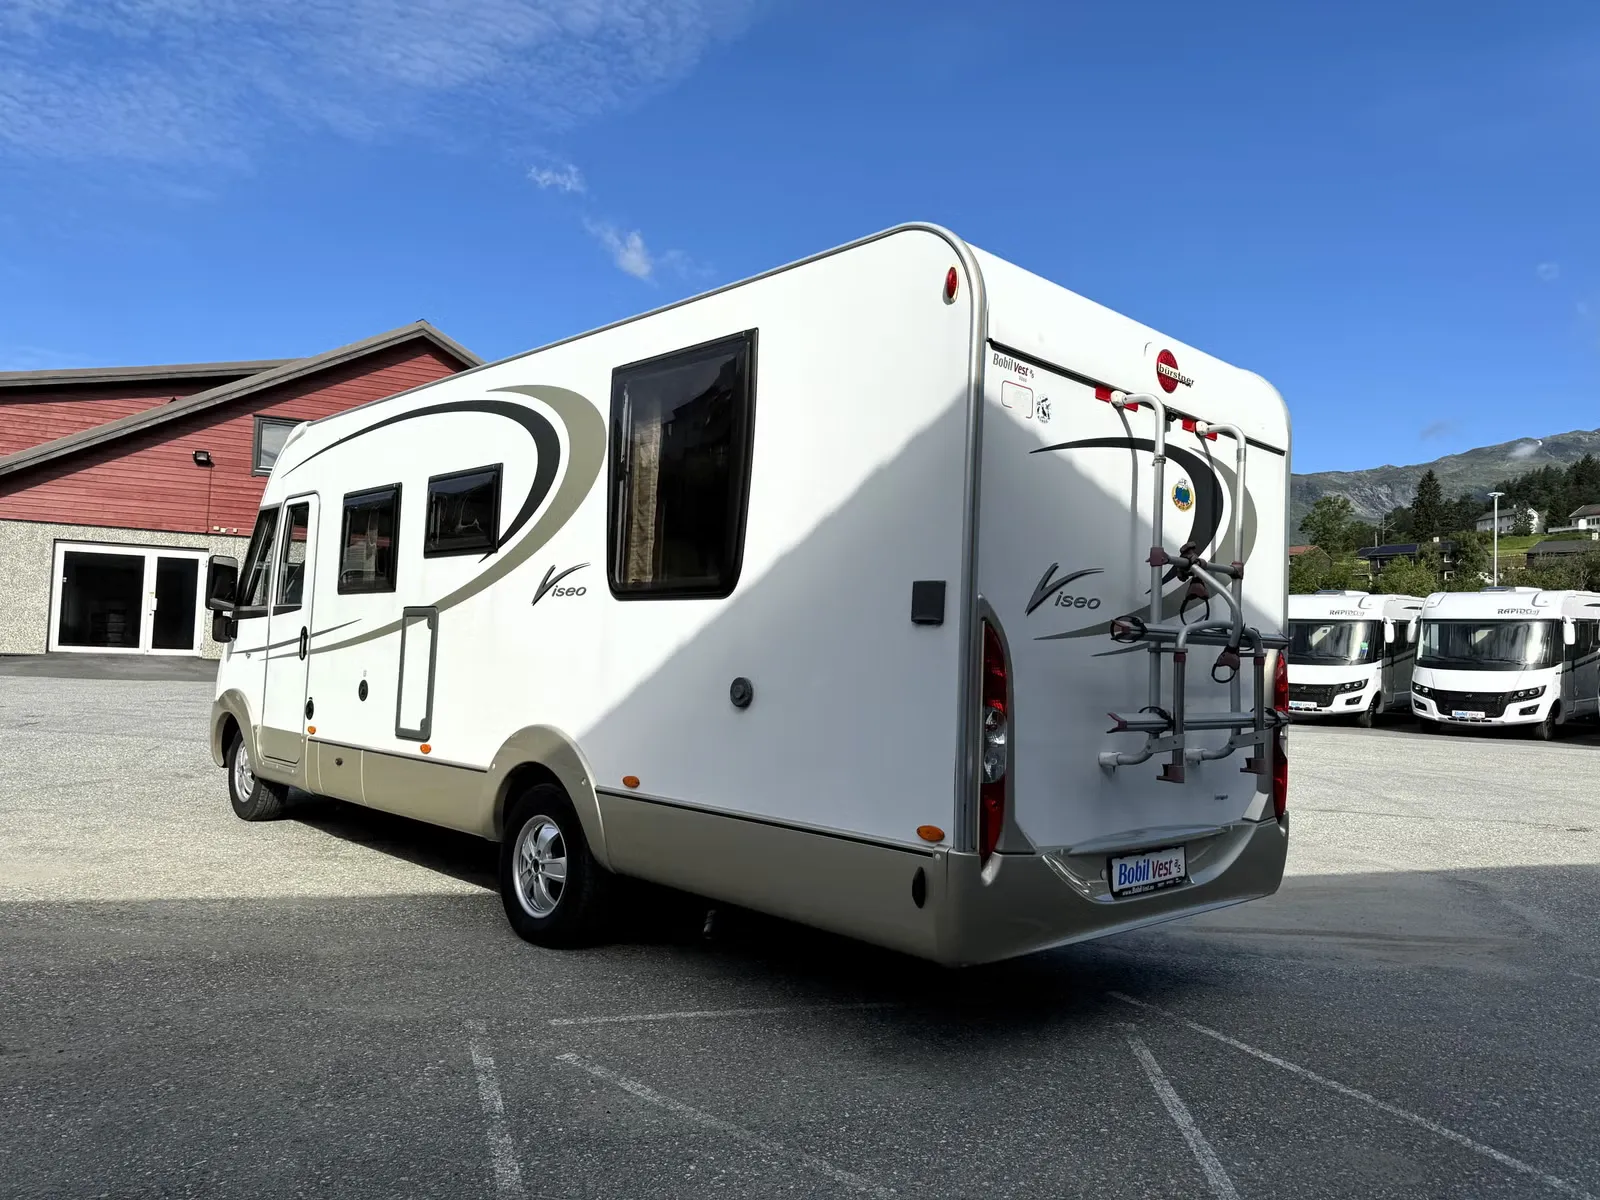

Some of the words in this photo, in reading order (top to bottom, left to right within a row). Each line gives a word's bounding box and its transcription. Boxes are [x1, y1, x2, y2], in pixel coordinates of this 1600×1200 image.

[993, 353, 1013, 371] Bobil
[1014, 361, 1029, 376] Vest
[1158, 363, 1195, 387] bürstner
[531, 562, 591, 606] Viseo
[1025, 562, 1104, 616] Viseo
[1118, 858, 1150, 886] Bobil
[1151, 858, 1173, 879] Vest
